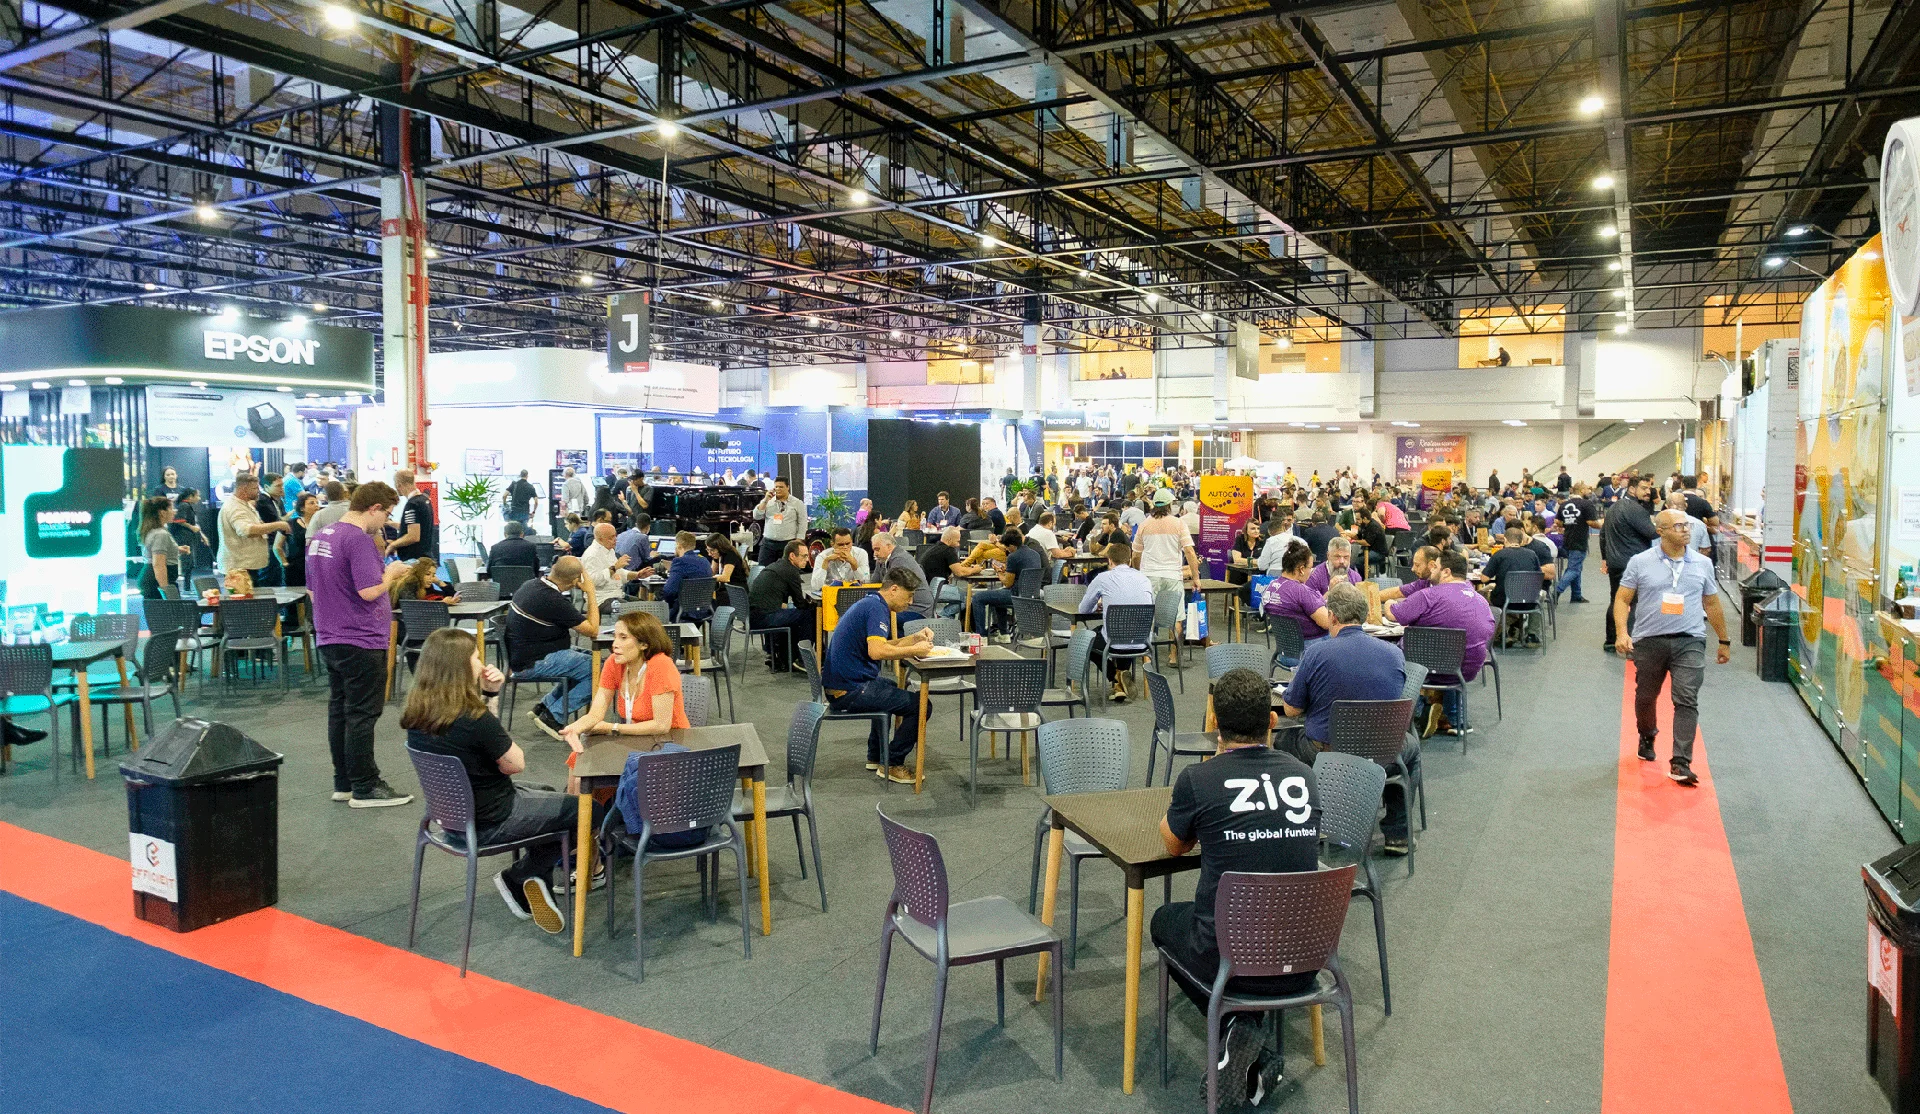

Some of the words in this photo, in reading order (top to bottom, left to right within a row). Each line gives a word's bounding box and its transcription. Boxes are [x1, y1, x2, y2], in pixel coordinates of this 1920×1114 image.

[617, 313, 639, 353] J
[203, 330, 316, 366] EPSON
[1207, 490, 1246, 499] AUTOCOM
[1223, 830, 1246, 841] The
[1248, 829, 1283, 841] global
[1285, 826, 1317, 838] funtech
